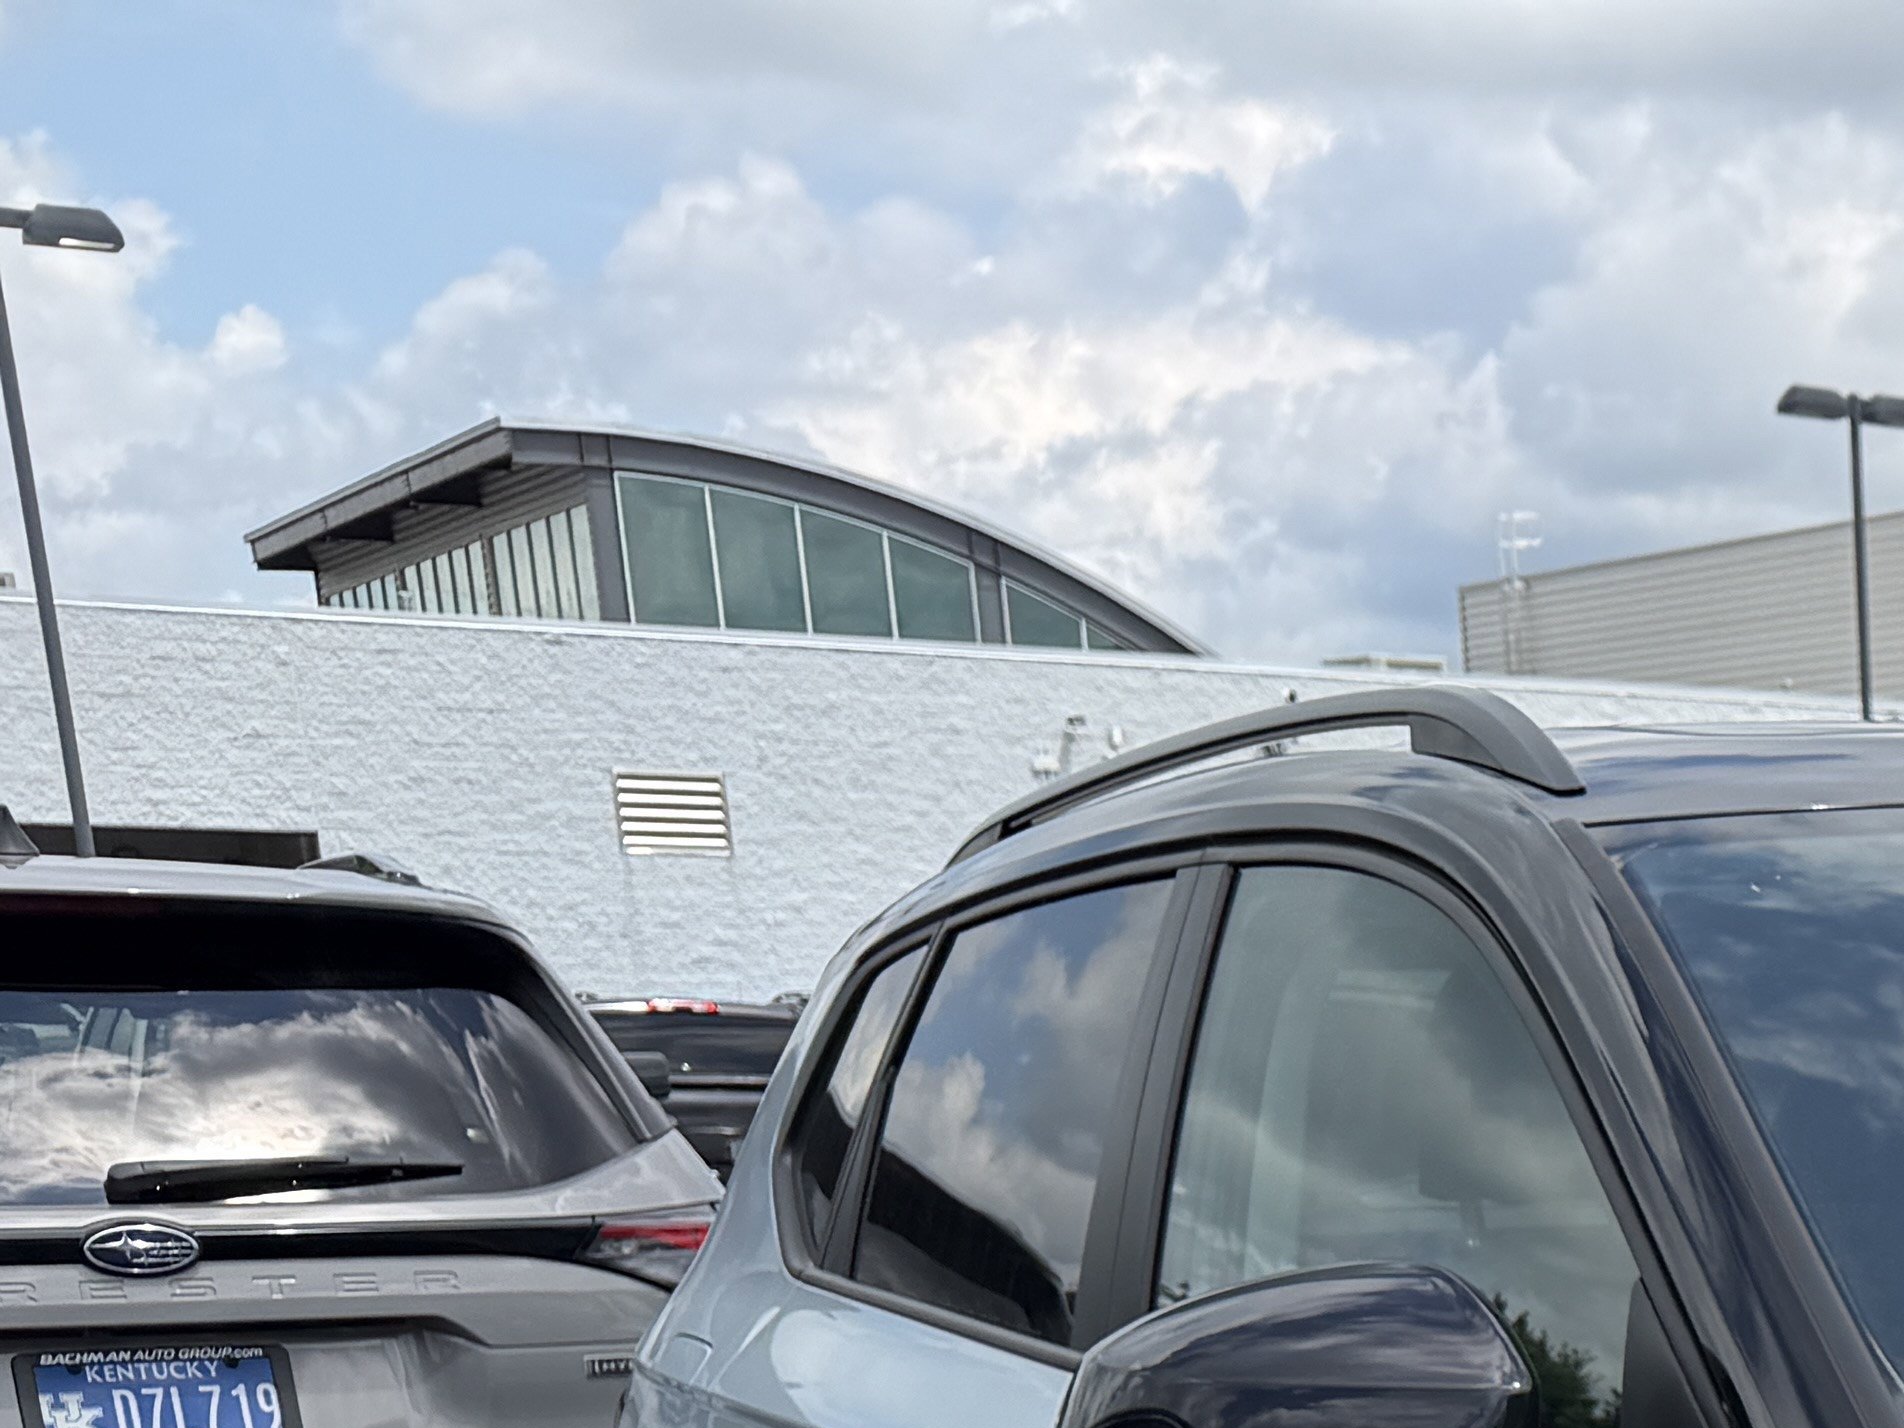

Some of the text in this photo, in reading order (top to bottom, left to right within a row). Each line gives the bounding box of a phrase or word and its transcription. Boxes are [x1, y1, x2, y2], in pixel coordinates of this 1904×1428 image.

[39, 1346, 263, 1366] BACHMAN AUTO GROUP.com
[85, 1360, 218, 1383] KENTUCKY
